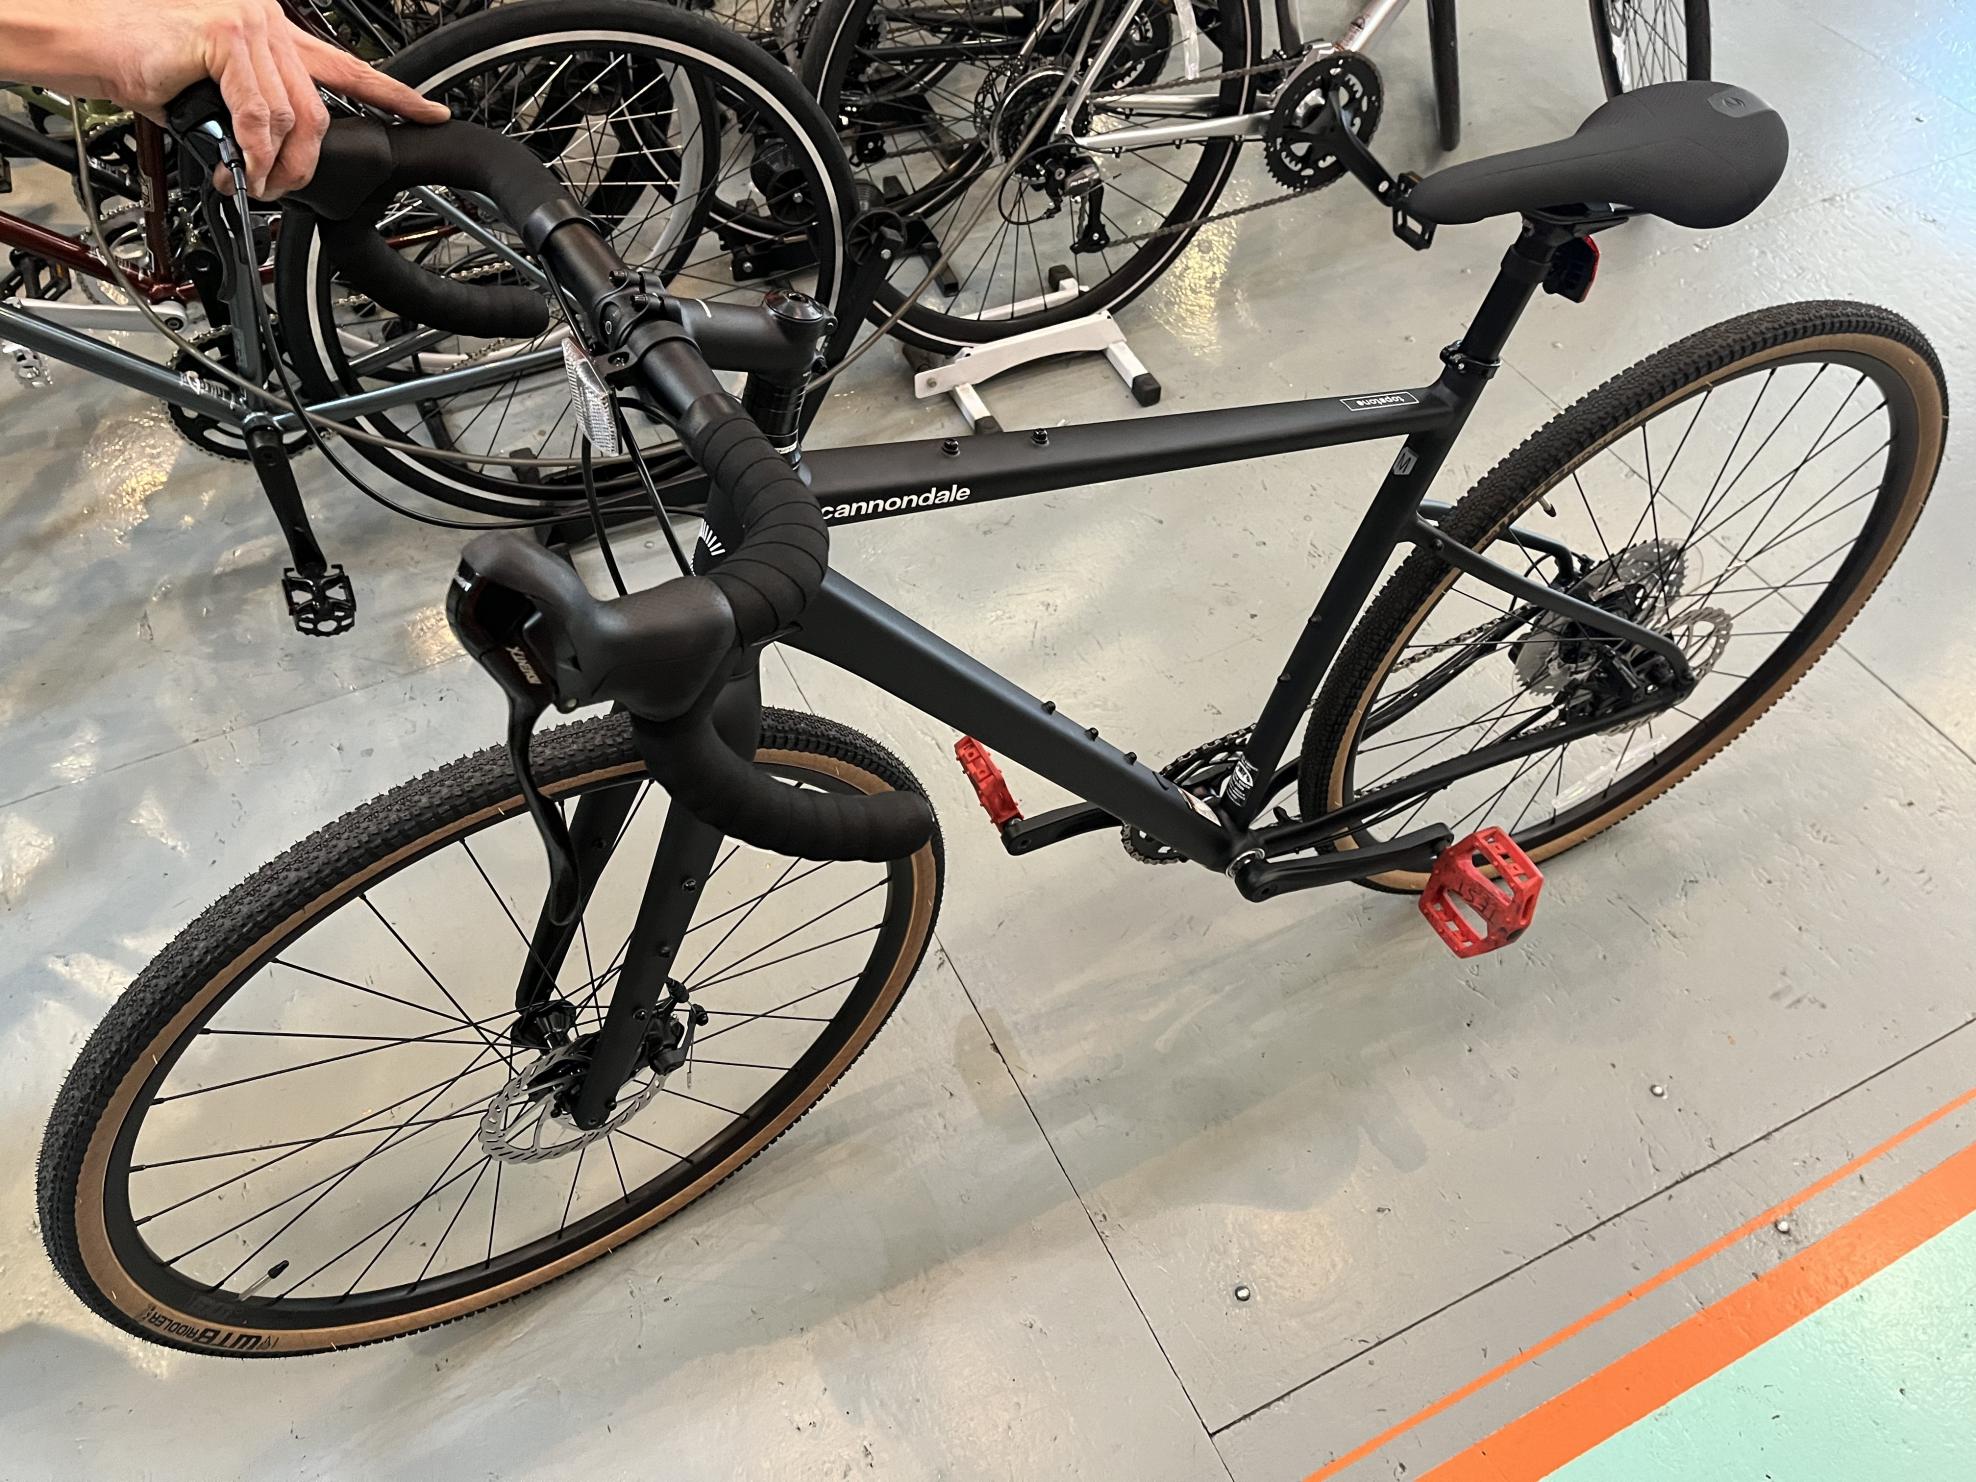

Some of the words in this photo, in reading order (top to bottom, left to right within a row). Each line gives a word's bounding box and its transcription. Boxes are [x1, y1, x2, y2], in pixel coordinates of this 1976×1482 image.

[1356, 395, 1405, 406] topstone
[822, 484, 971, 520] cannondale
[1448, 880, 1494, 924] TEST
[149, 1313, 200, 1339] RIDDLER
[193, 1327, 262, 1350] WTB
